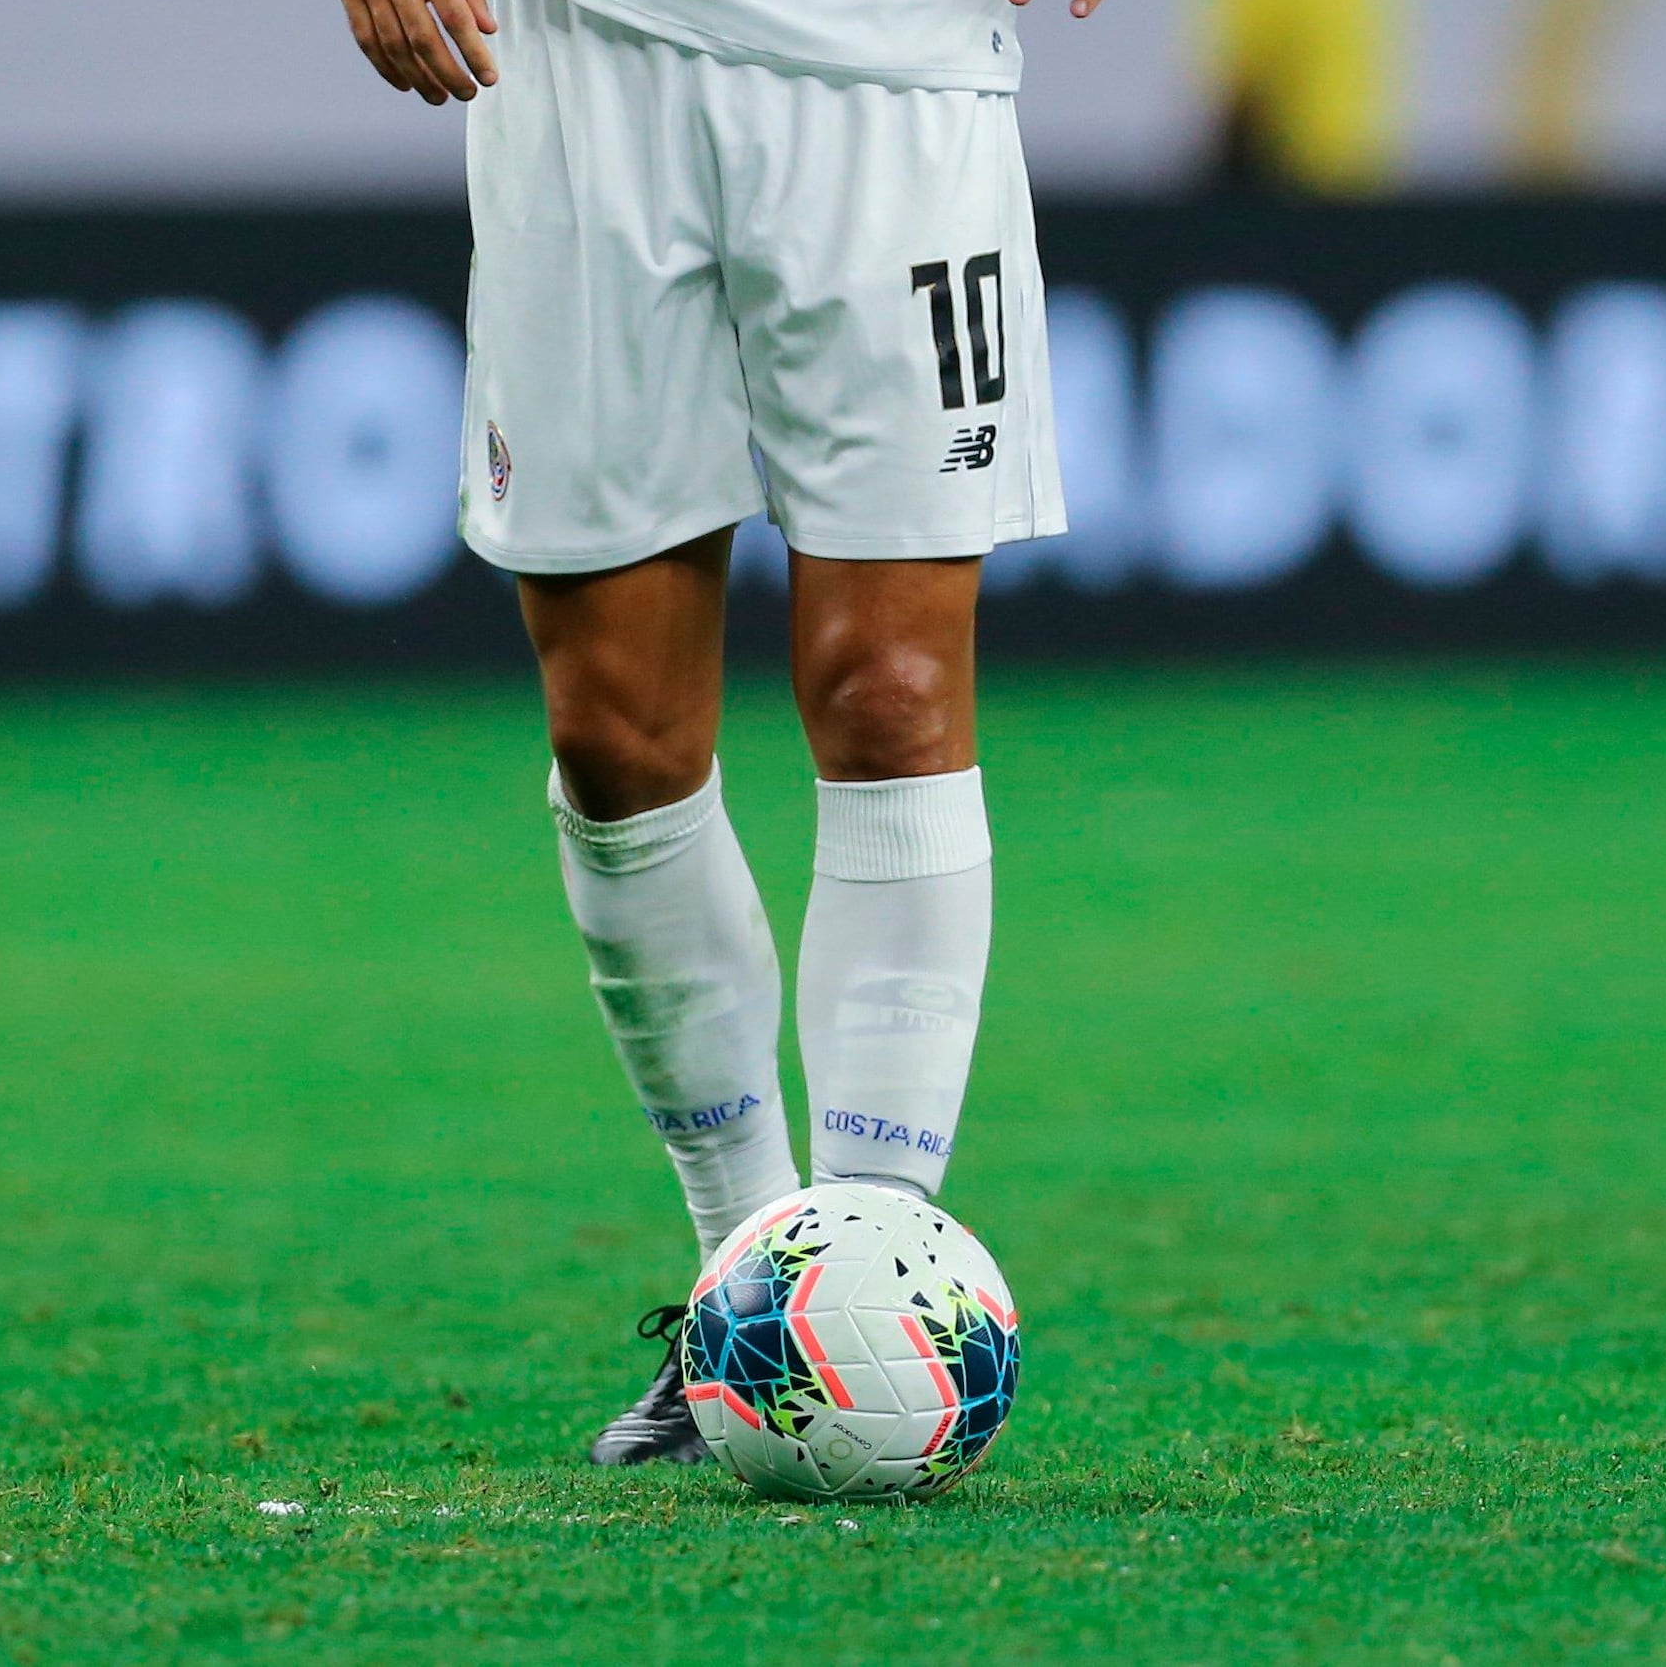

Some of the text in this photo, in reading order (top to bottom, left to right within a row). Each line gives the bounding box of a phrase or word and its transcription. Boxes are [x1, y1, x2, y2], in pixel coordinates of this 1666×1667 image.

[910, 248, 1005, 410] 10
[691, 1094, 761, 1129] RICA
[825, 1109, 910, 1147] COSTA
